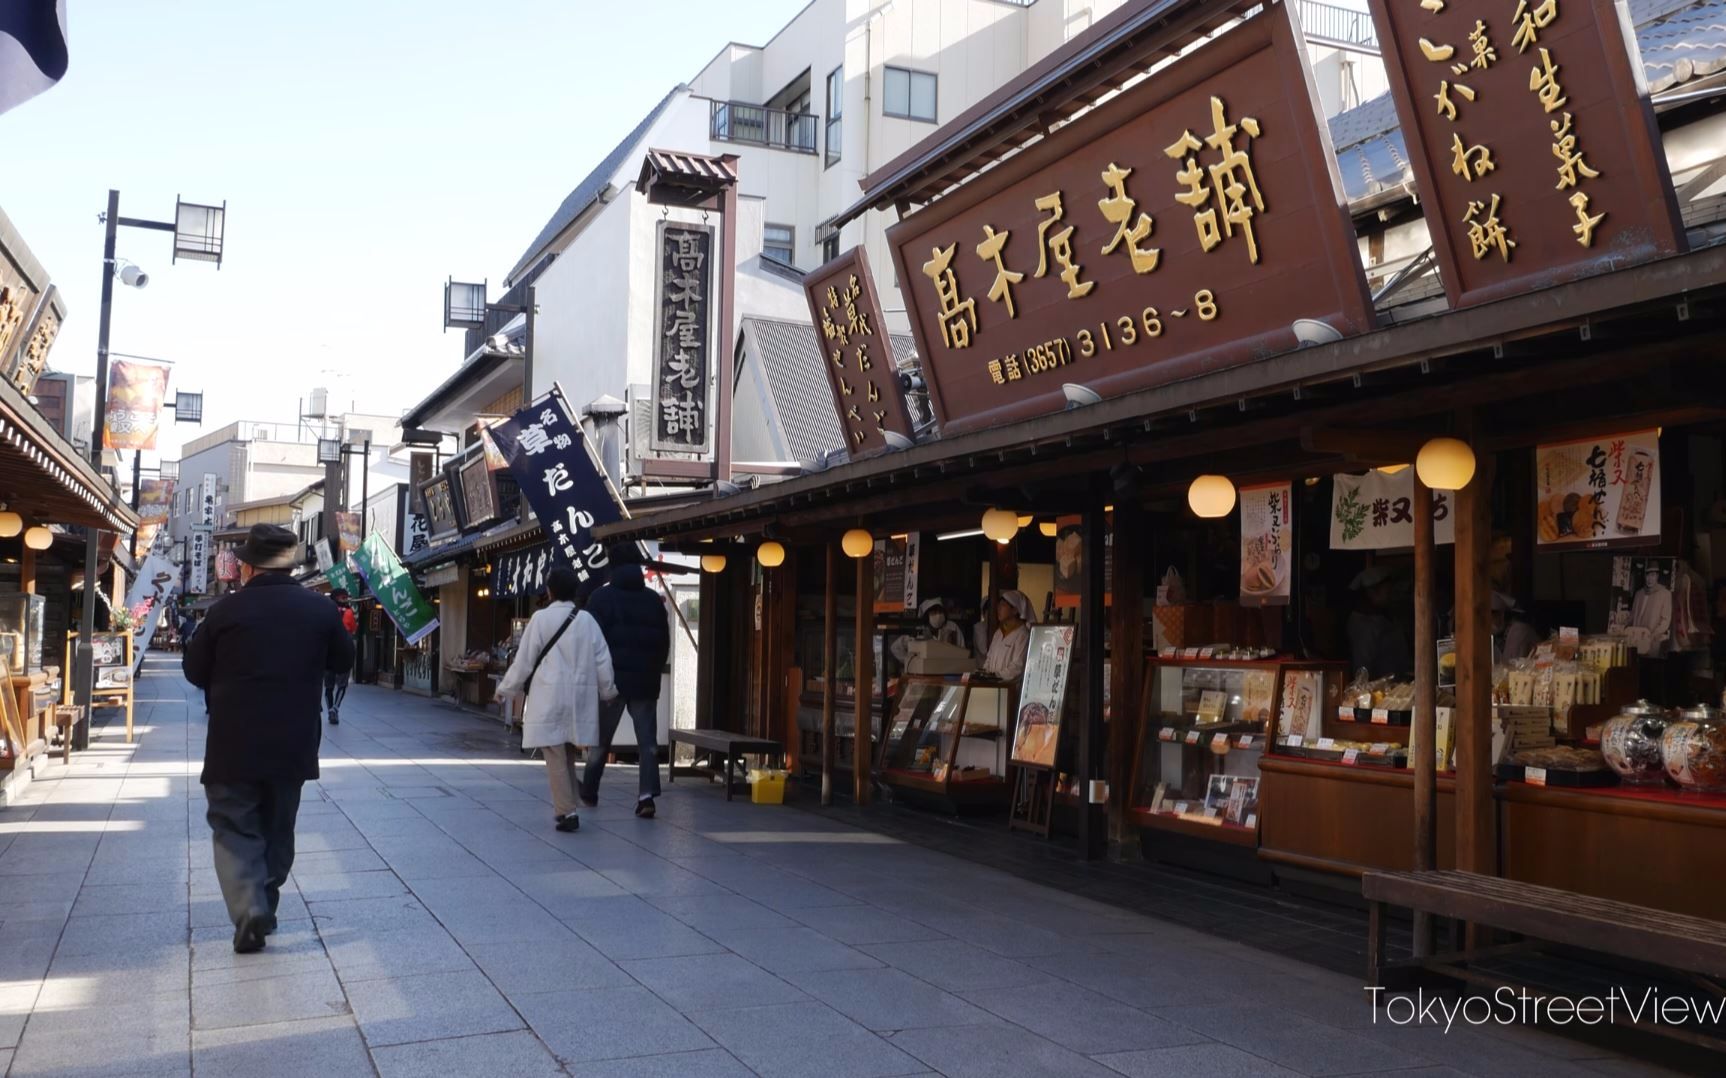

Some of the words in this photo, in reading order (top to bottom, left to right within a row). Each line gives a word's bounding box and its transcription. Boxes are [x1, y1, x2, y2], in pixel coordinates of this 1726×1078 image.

[539, 408, 572, 450] 名物
[1372, 493, 1449, 527] 柴又ち
